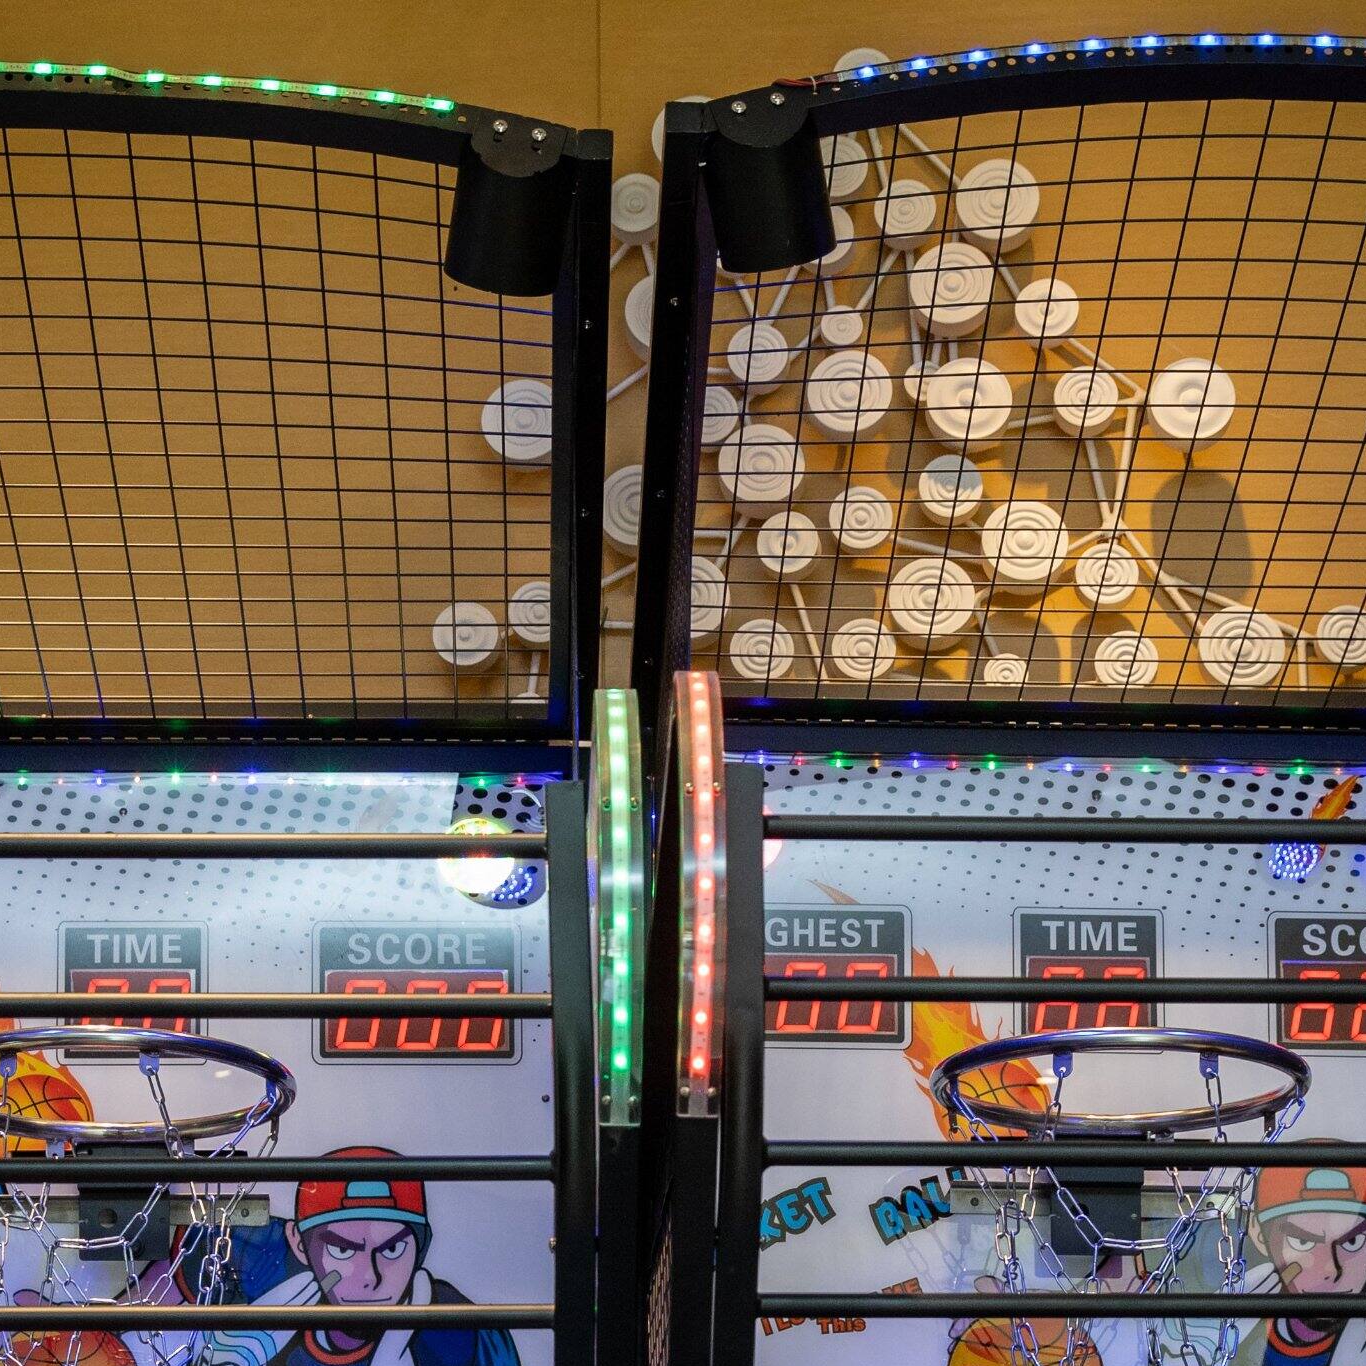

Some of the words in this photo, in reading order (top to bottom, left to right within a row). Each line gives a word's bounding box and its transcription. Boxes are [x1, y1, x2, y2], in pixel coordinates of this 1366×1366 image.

[86, 933, 183, 964] TIME
[347, 932, 487, 965] SCORE
[765, 917, 886, 949] GHEST
[1041, 920, 1138, 952] TIME
[816, 1318, 867, 1335] This
